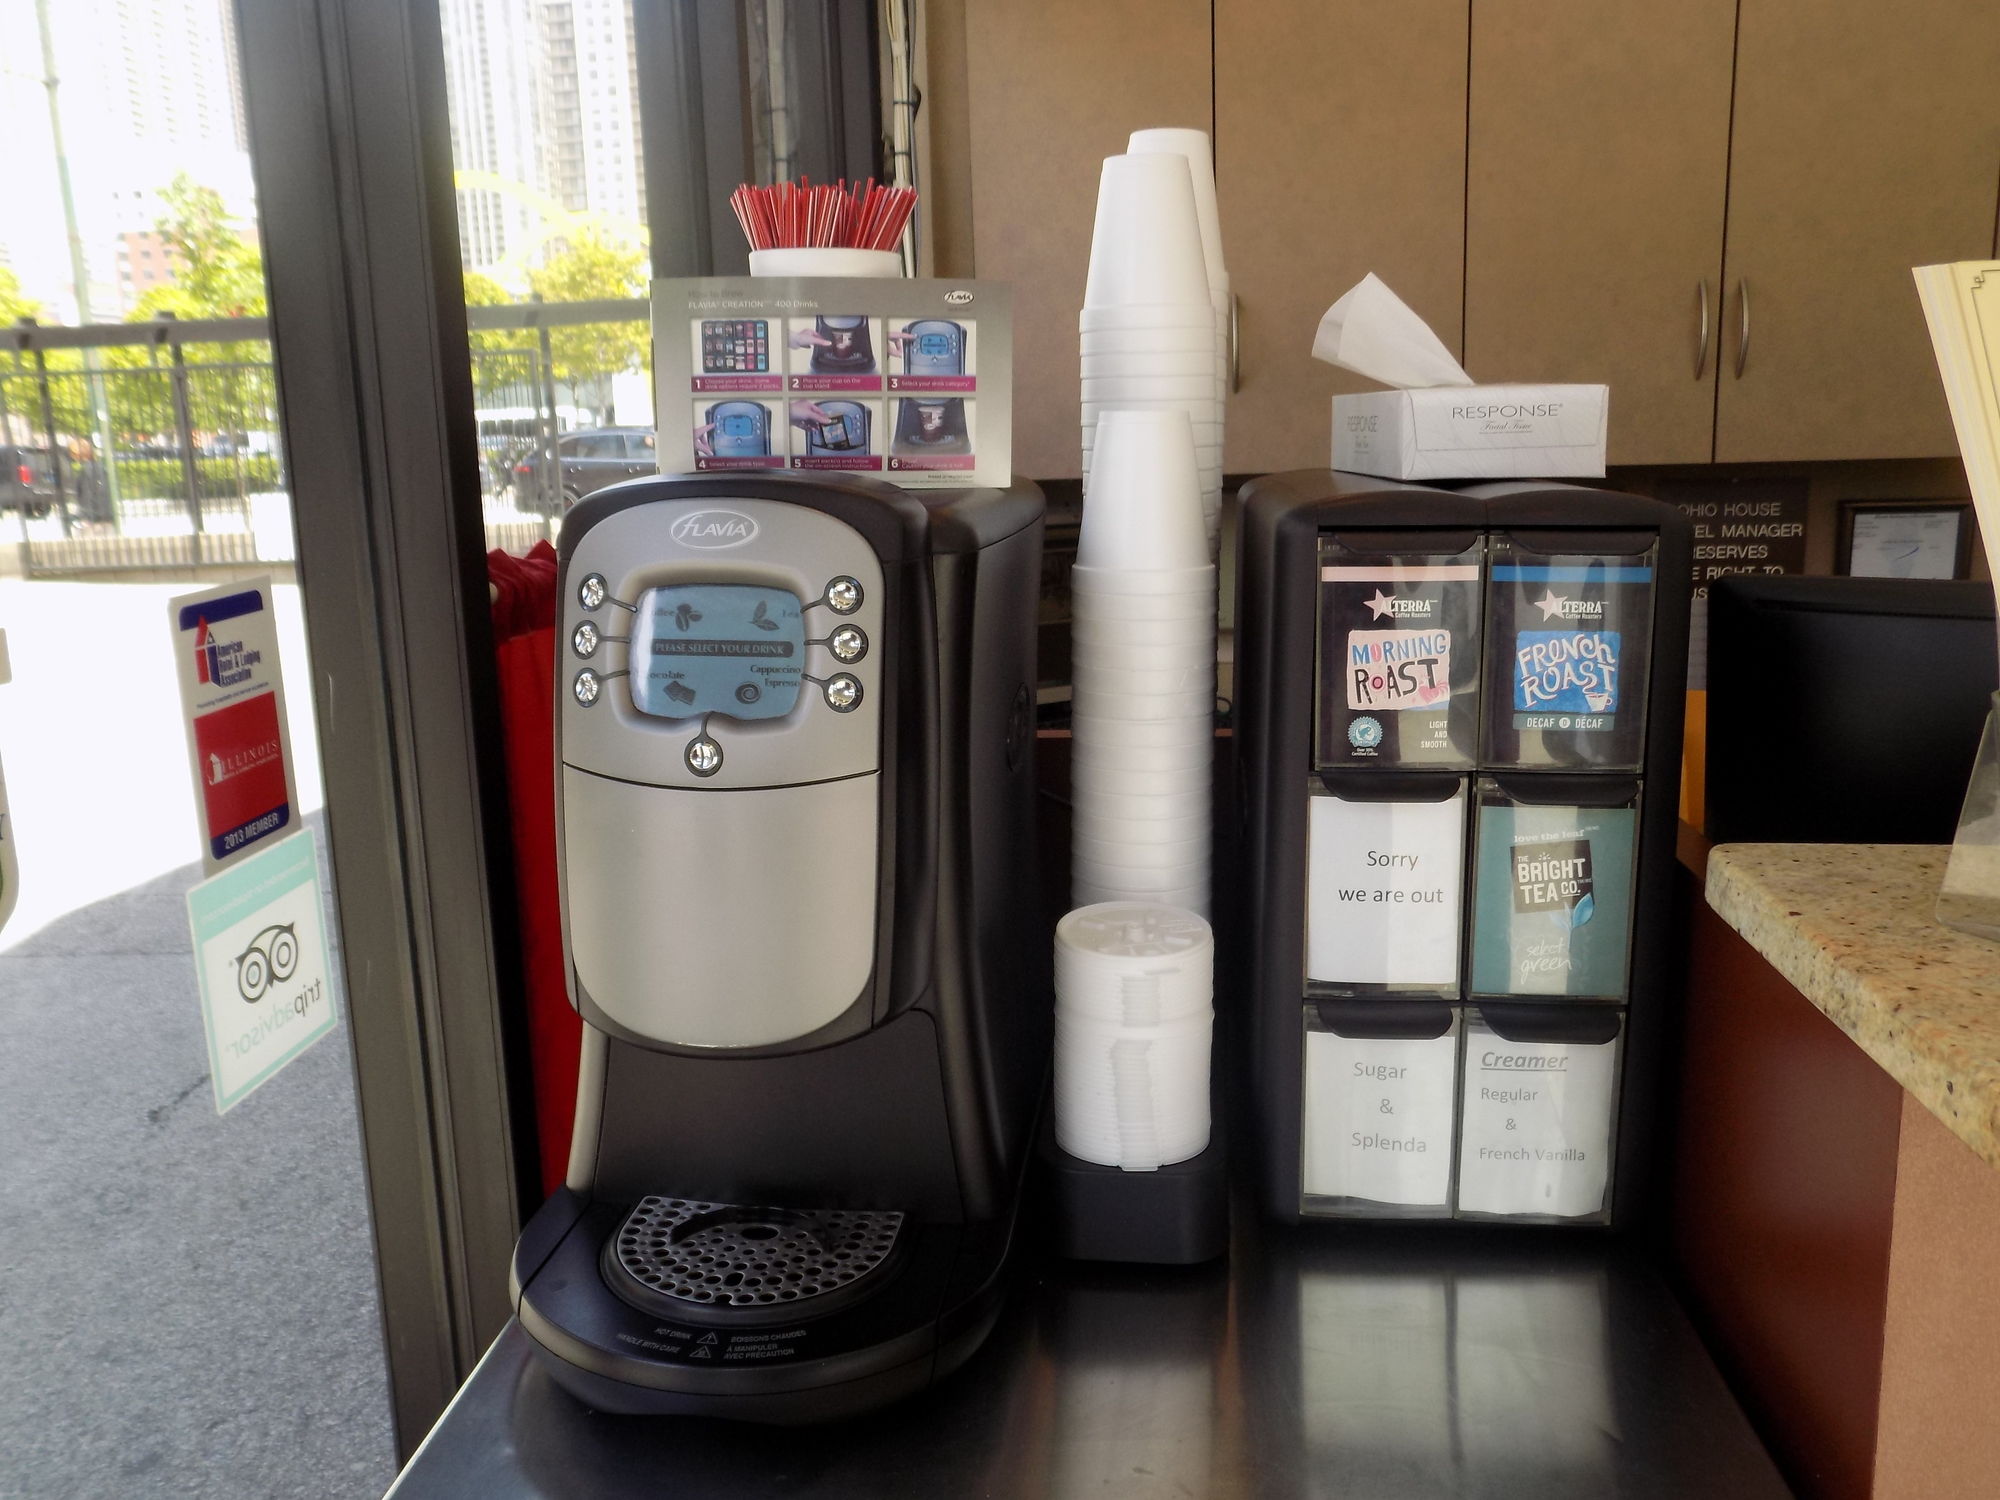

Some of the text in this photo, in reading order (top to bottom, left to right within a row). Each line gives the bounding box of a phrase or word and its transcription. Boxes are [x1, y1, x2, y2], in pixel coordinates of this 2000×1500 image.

[722, 299, 764, 309] CREATION
[774, 299, 791, 308] 400
[793, 299, 818, 308] Drinks
[695, 379, 701, 389] 1
[791, 378, 799, 388] 2
[891, 378, 898, 388] 3
[1452, 403, 1559, 420] RESPONSE
[698, 459, 706, 469] 4
[794, 459, 801, 468] 5
[891, 459, 898, 468] 6
[1677, 503, 1782, 517] OHIO HOUSE
[678, 514, 746, 539] FLAVIA
[1721, 524, 1803, 538] MANAGER
[1693, 545, 1768, 559] ESERVES
[1381, 599, 1431, 612] ALTERRA
[1552, 601, 1602, 613] ALTERRA
[654, 608, 675, 617] offee
[655, 643, 785, 654] PLEASE SELECT YOUR DRINK
[1352, 633, 1447, 666] MORNING
[650, 671, 686, 680] ocolate
[751, 665, 800, 678] Cappuccino
[1355, 658, 1440, 705] ROAST
[1520, 661, 1615, 708] ROAST
[1429, 720, 1448, 729] LIGHT
[1526, 717, 1555, 728] DECAF
[1575, 715, 1603, 728] DÉCAF
[221, 740, 280, 774] ILLINOIS
[224, 812, 279, 849] 2013 MEMBER
[1541, 832, 1560, 840] the
[1366, 850, 1419, 871] Sorry
[1517, 858, 1586, 883] BRIGHT
[1338, 887, 1443, 903] we are out
[1520, 880, 1581, 905] TEA CO.
[1521, 958, 1573, 984] green
[1481, 1051, 1568, 1069] Creamer
[1352, 1062, 1407, 1080] Sugar
[1481, 1087, 1538, 1103] Regular
[1379, 1099, 1394, 1114] &
[1505, 1118, 1517, 1130] &
[1351, 1132, 1427, 1153] Splenda
[1479, 1148, 1585, 1161] French Vanilla
[730, 1334, 769, 1343] BOISSONS
[723, 1352, 744, 1360] AVEC
